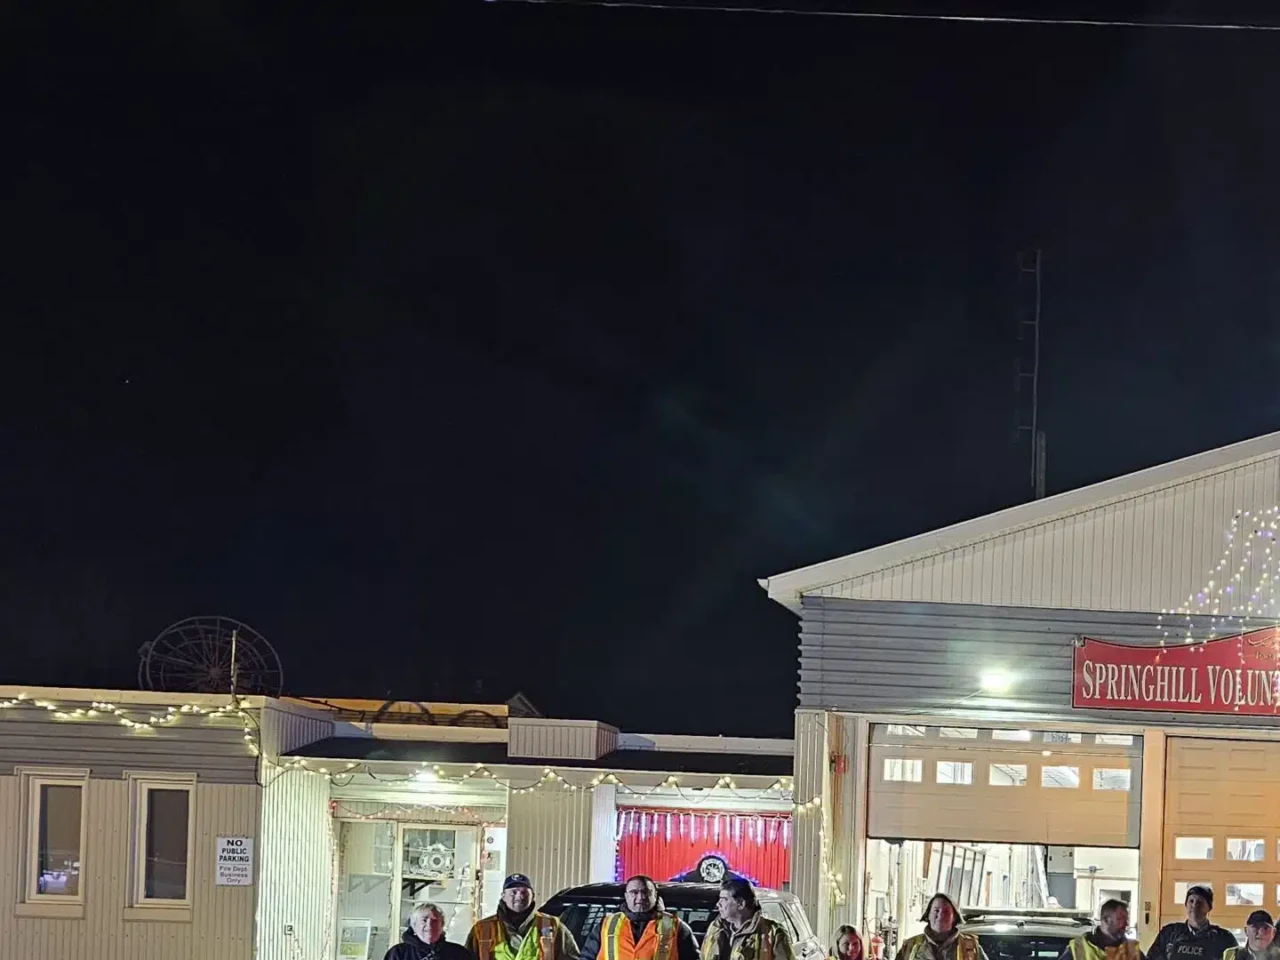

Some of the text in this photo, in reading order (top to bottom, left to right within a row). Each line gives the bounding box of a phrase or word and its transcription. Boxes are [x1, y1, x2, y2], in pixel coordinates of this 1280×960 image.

[1082, 660, 1202, 703] SPRINGHILL
[226, 839, 243, 847] NO
[1177, 946, 1204, 956] POLICE
